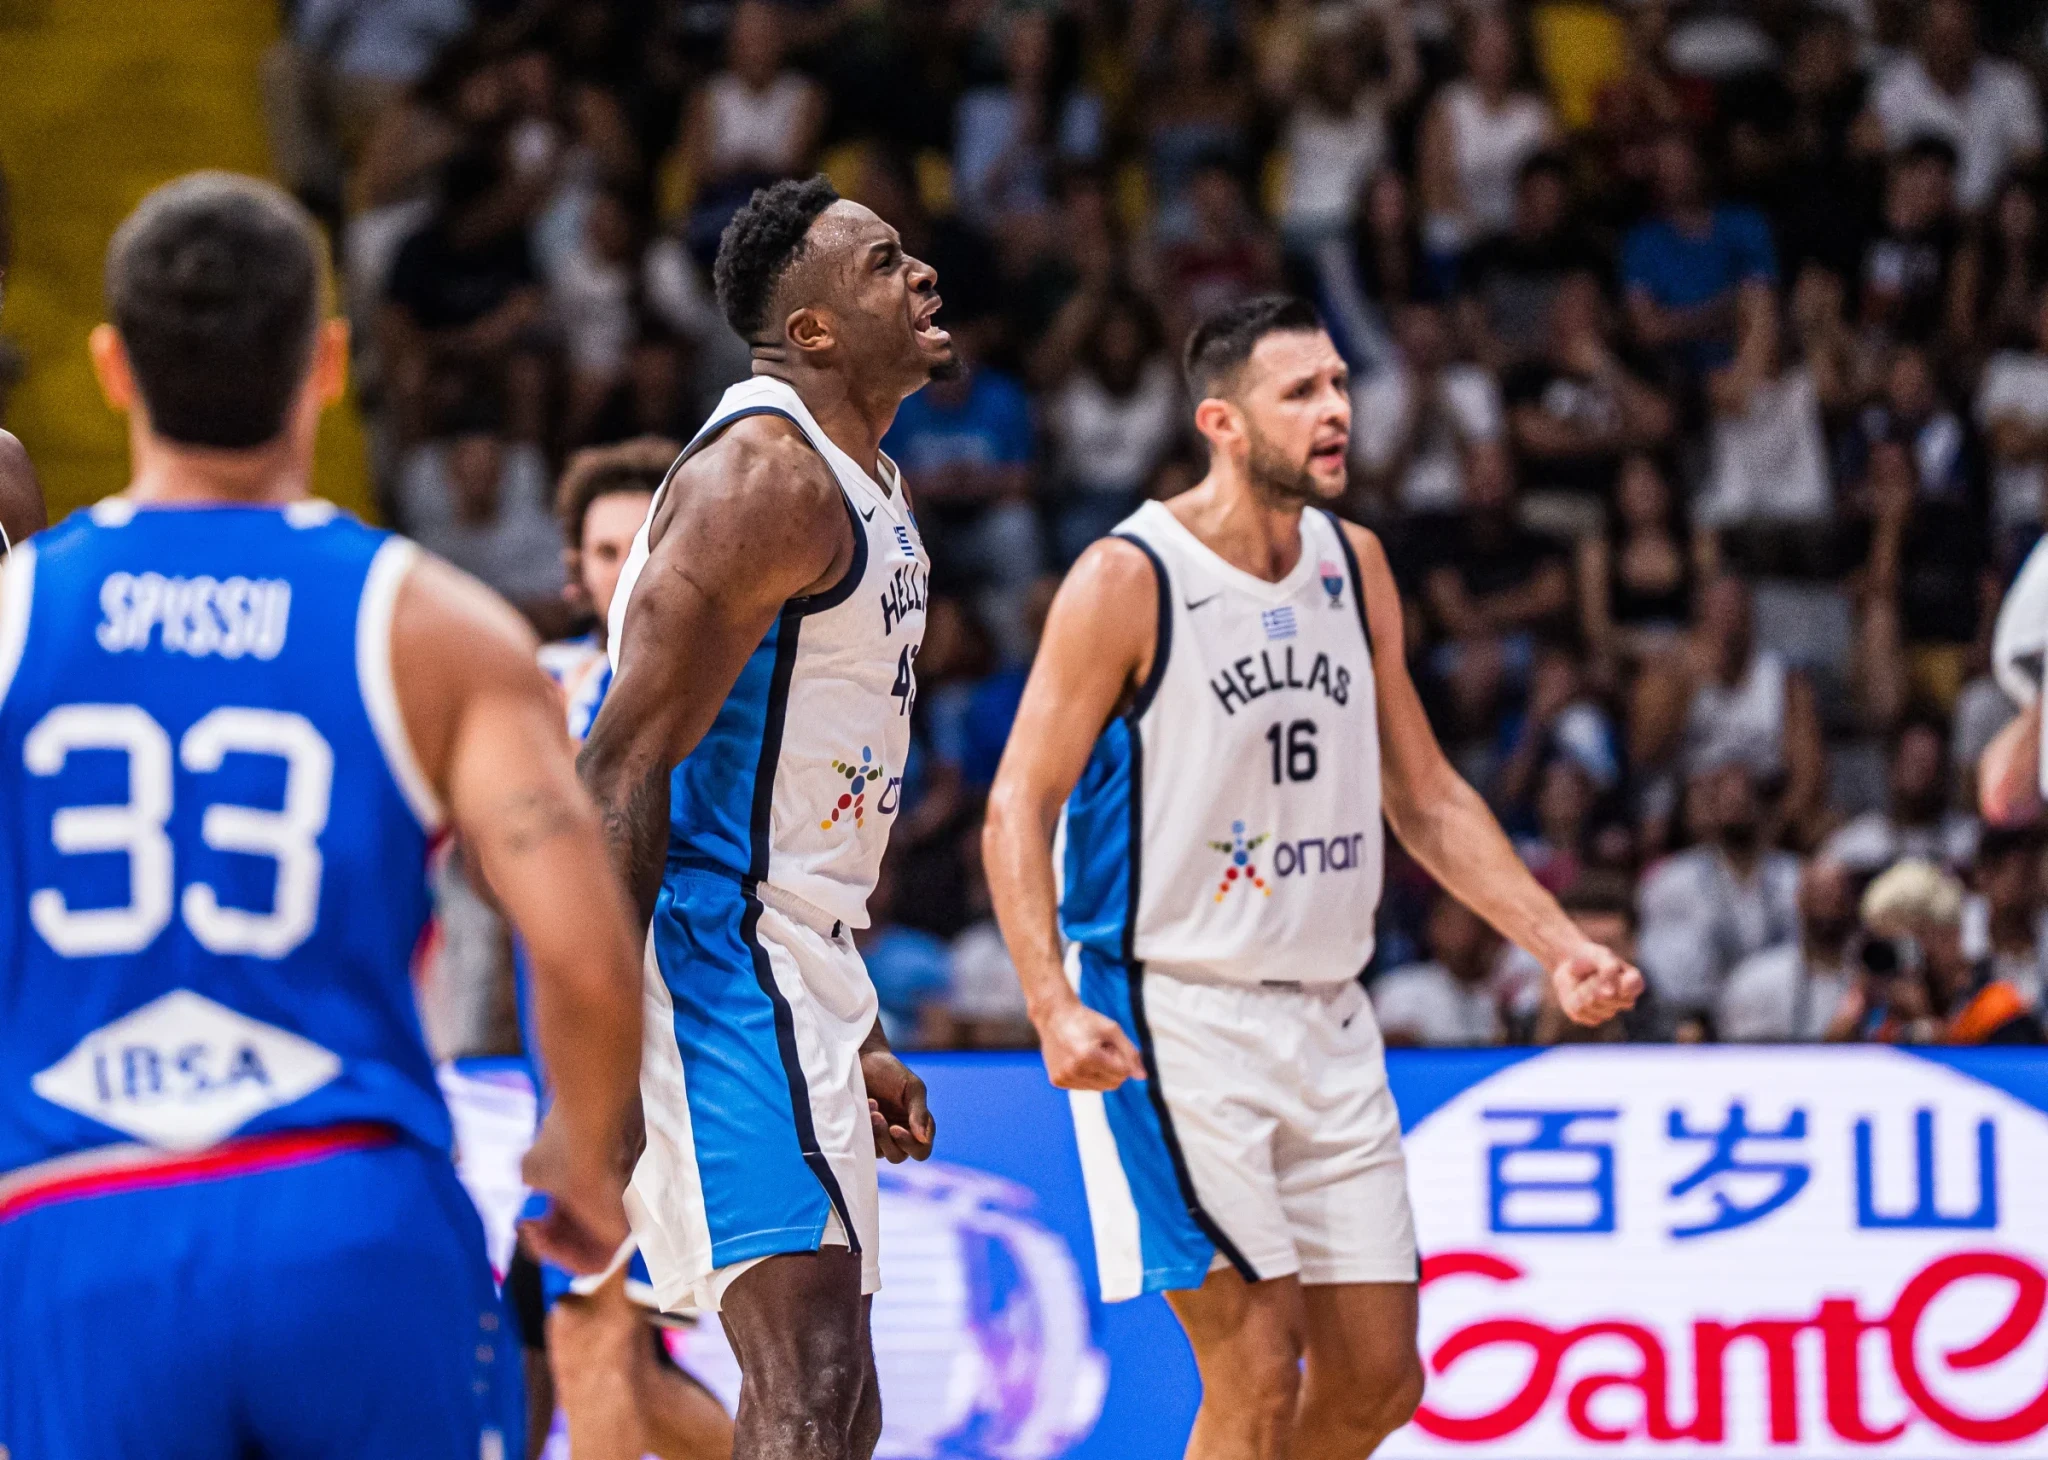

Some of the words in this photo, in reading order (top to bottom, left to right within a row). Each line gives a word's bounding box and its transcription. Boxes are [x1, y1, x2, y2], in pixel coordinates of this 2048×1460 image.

[1209, 646, 1351, 715] HELLAS
[1265, 718, 1319, 785] 16
[23, 703, 334, 960] 33
[94, 1041, 271, 1102] IBSA
[1481, 1097, 1999, 1239] 百岁山
